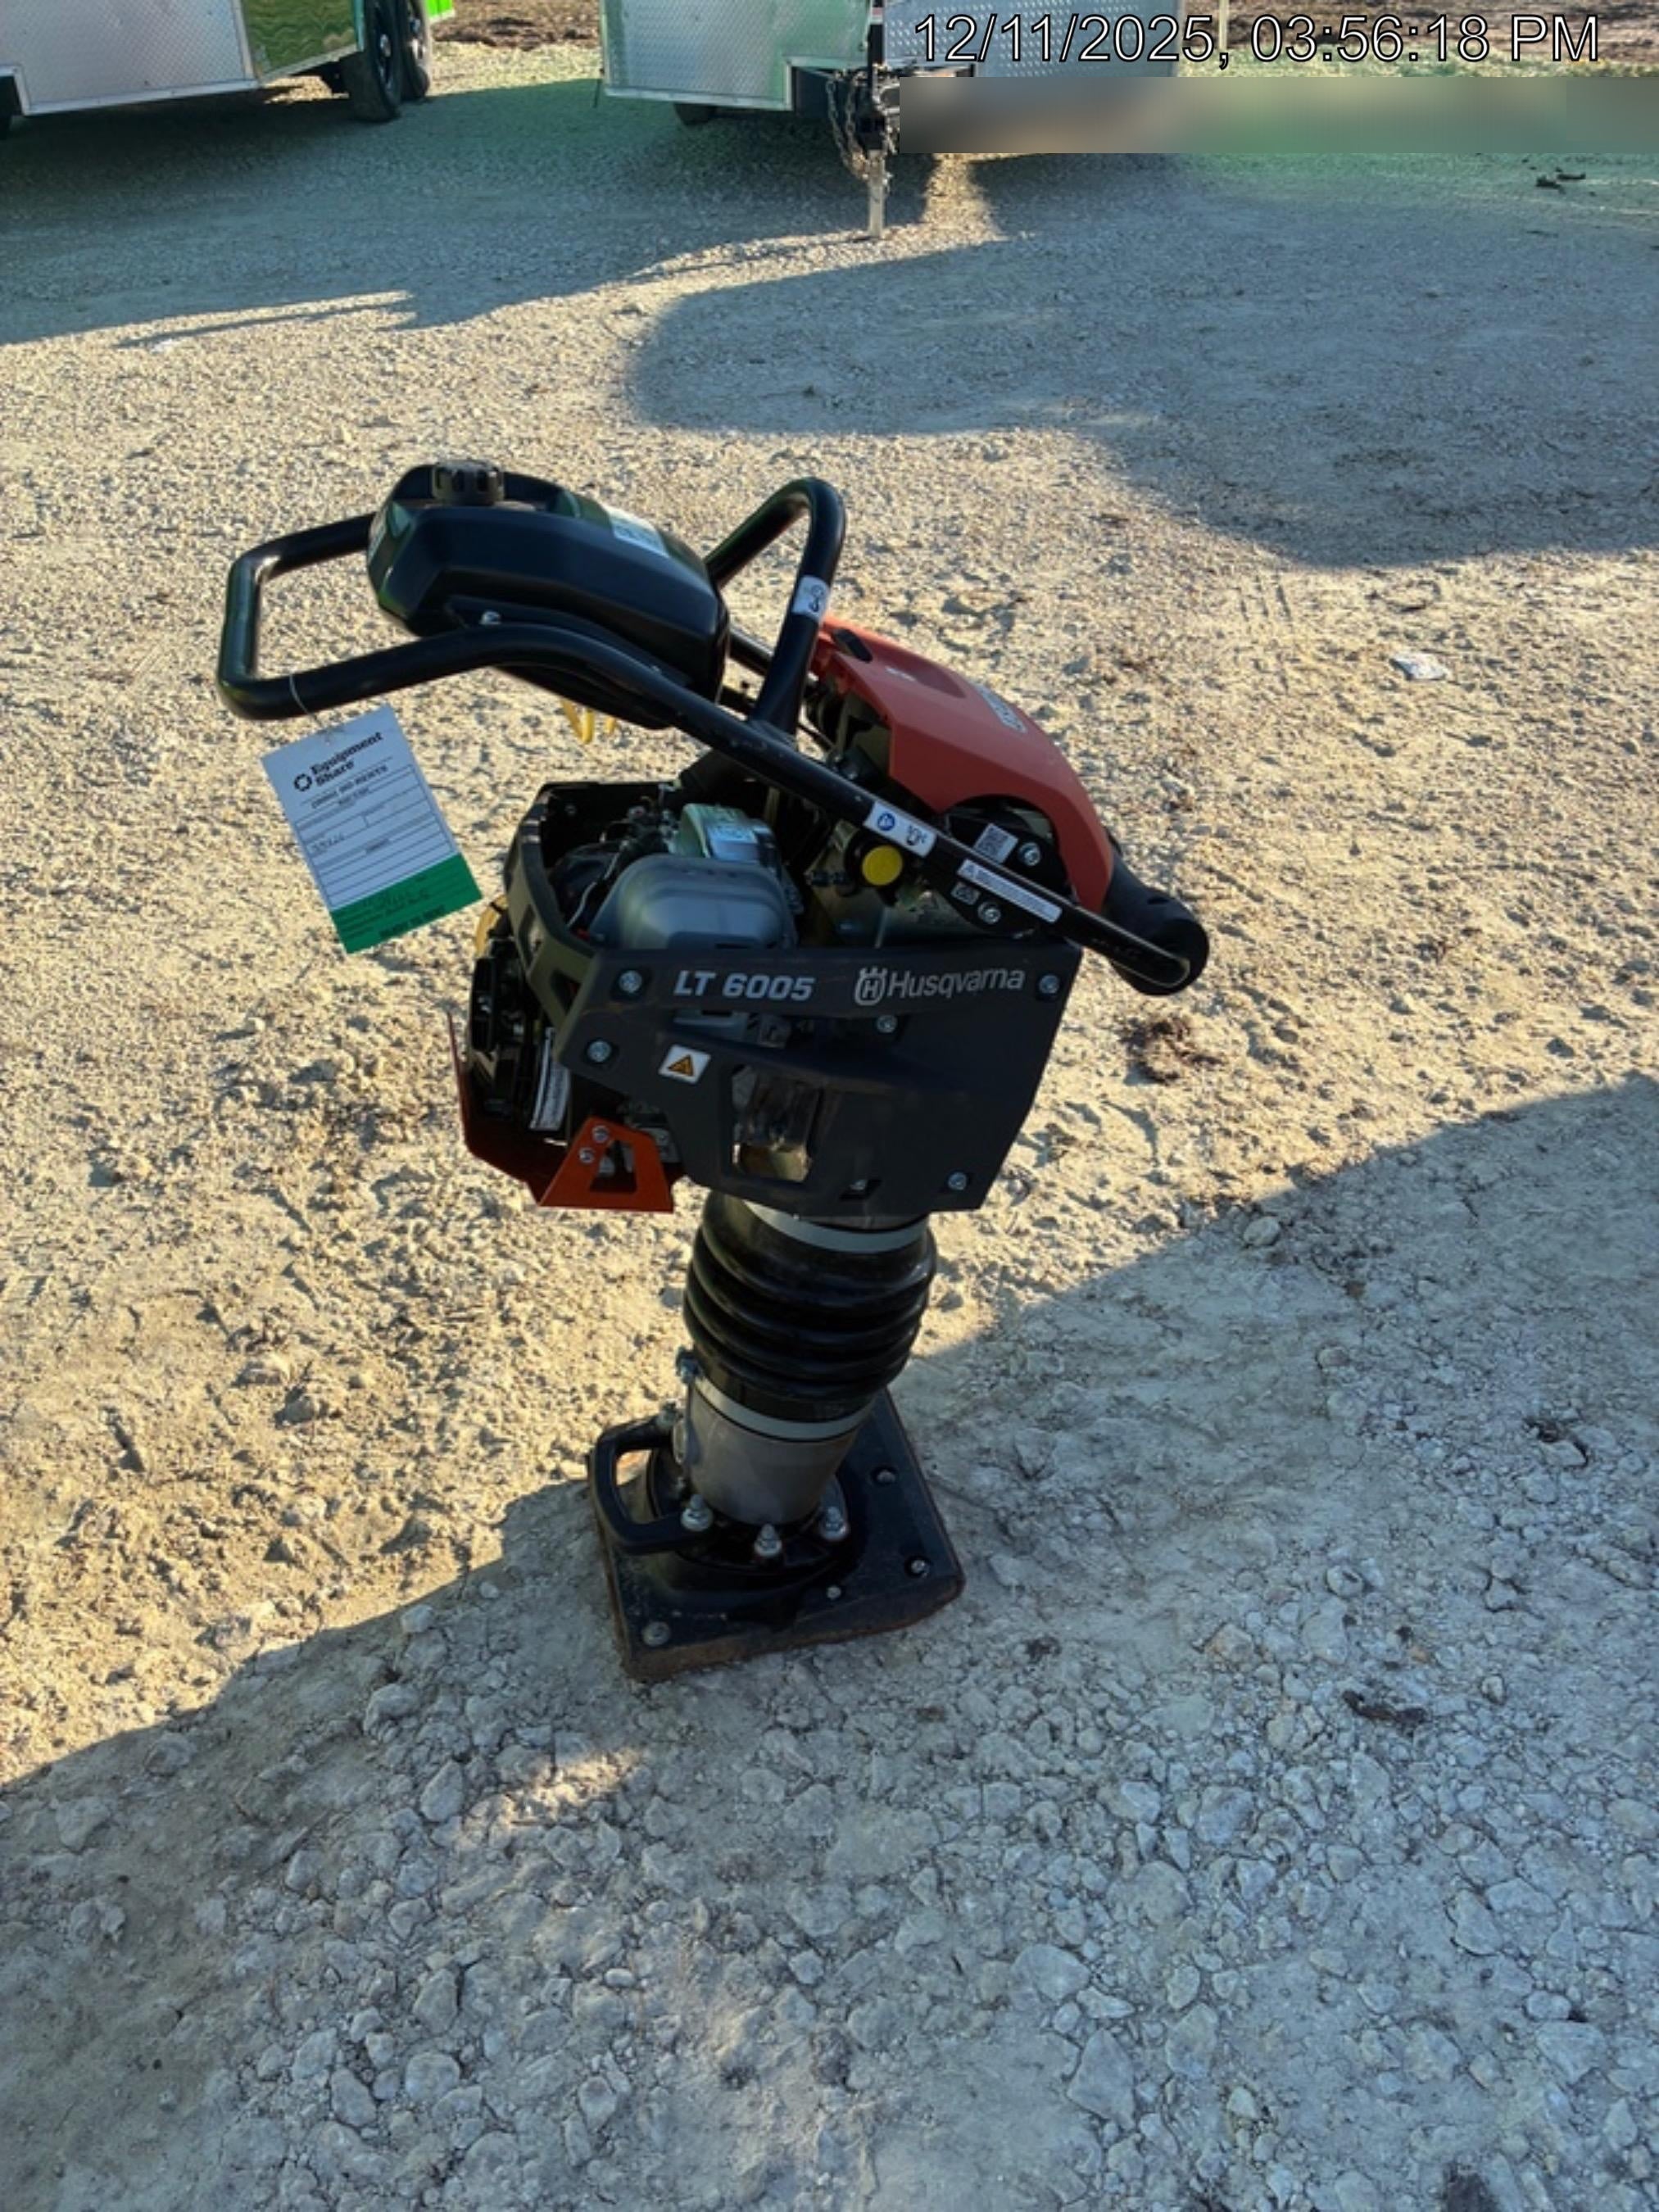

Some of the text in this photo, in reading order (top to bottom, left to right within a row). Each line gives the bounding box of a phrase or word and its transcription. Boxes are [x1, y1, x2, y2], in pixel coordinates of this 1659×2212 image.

[310, 732, 383, 775] Equipment
[315, 759, 355, 787] Share
[673, 970, 816, 1001] LT 6005
[887, 966, 1027, 999] Husqvarna
